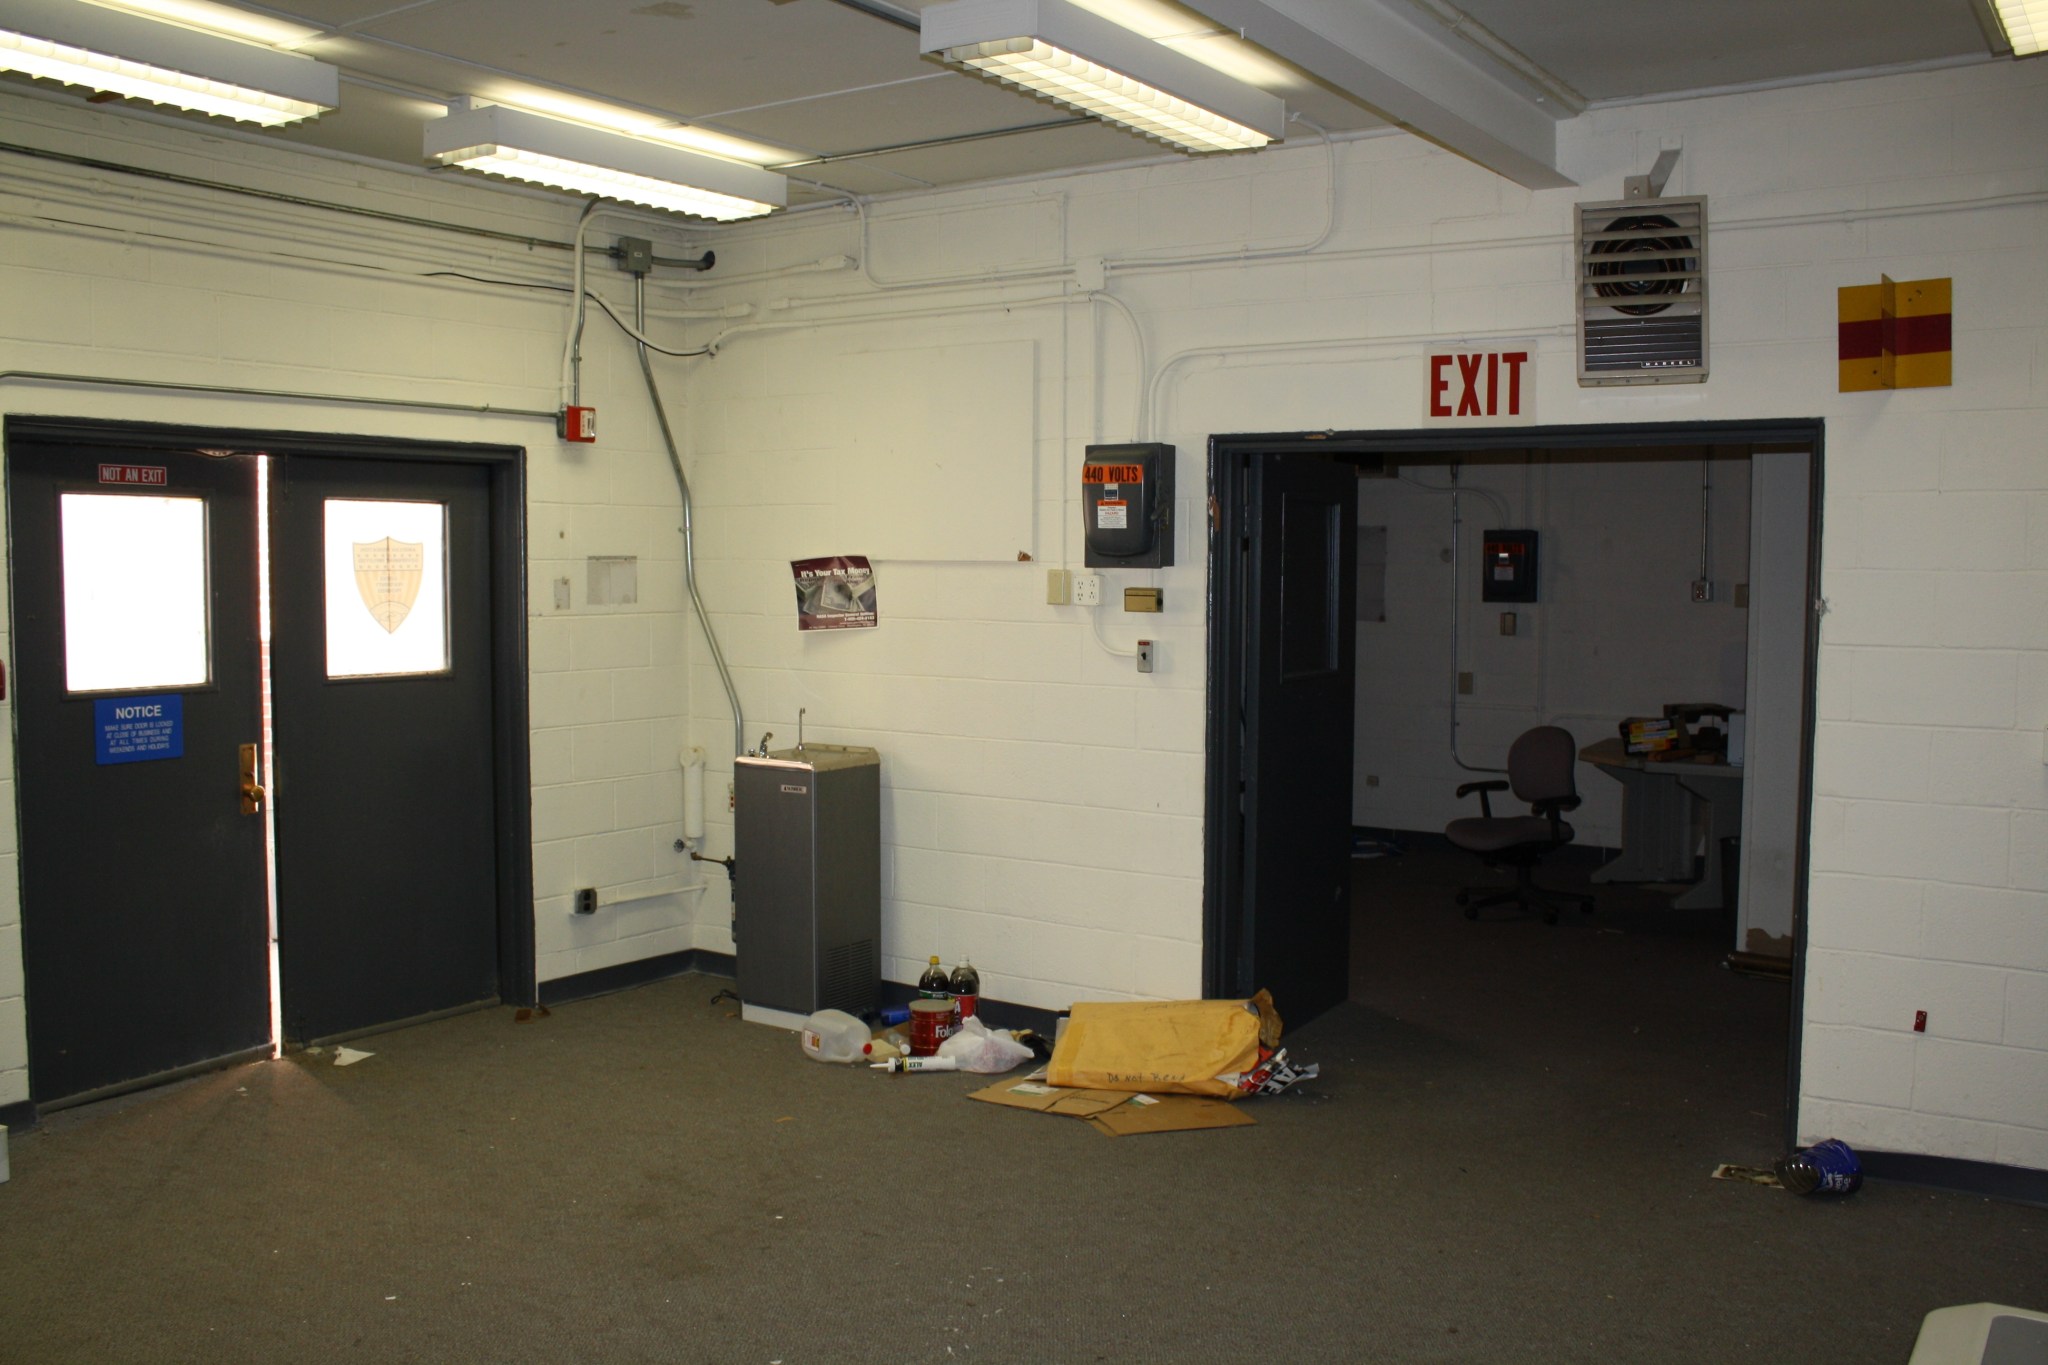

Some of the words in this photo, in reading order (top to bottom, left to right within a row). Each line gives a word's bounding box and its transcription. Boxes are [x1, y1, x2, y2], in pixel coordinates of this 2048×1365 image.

[1430, 352, 1528, 417] EXIT
[102, 467, 121, 481] NOT
[125, 468, 139, 482] AN
[142, 469, 163, 482] EXIT
[1085, 466, 1103, 482] 440
[1109, 466, 1138, 482] VOLTS
[815, 569, 832, 577] Your
[833, 568, 846, 576] Tax
[847, 567, 870, 575] Money
[115, 705, 162, 719] NOTICE
[149, 735, 169, 743] DURING
